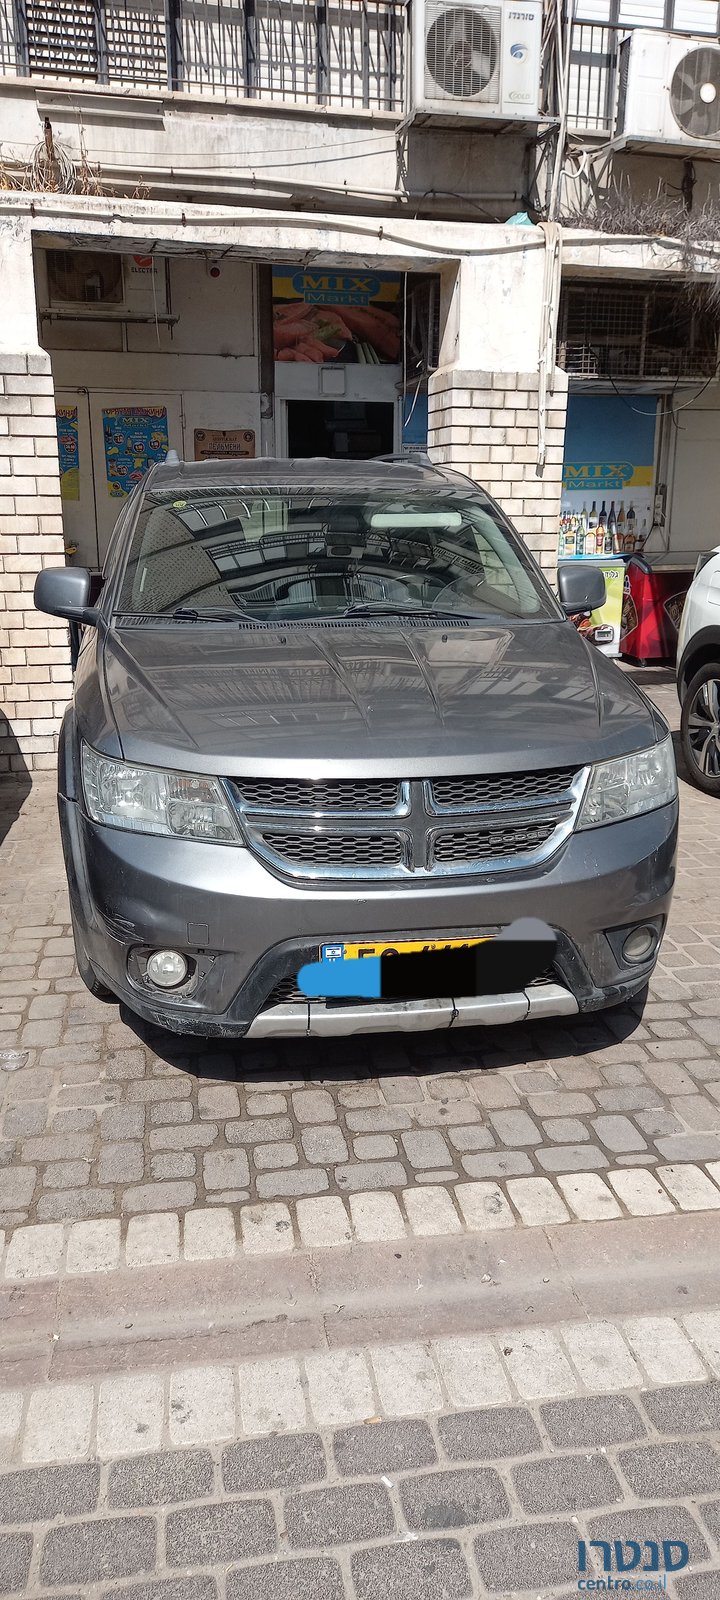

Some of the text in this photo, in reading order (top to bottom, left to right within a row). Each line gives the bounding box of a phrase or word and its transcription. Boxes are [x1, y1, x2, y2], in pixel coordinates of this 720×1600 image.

[302, 274, 373, 292] MIX
[308, 293, 366, 304] Markt
[564, 465, 628, 478] MIX
[568, 480, 621, 488] Markt
